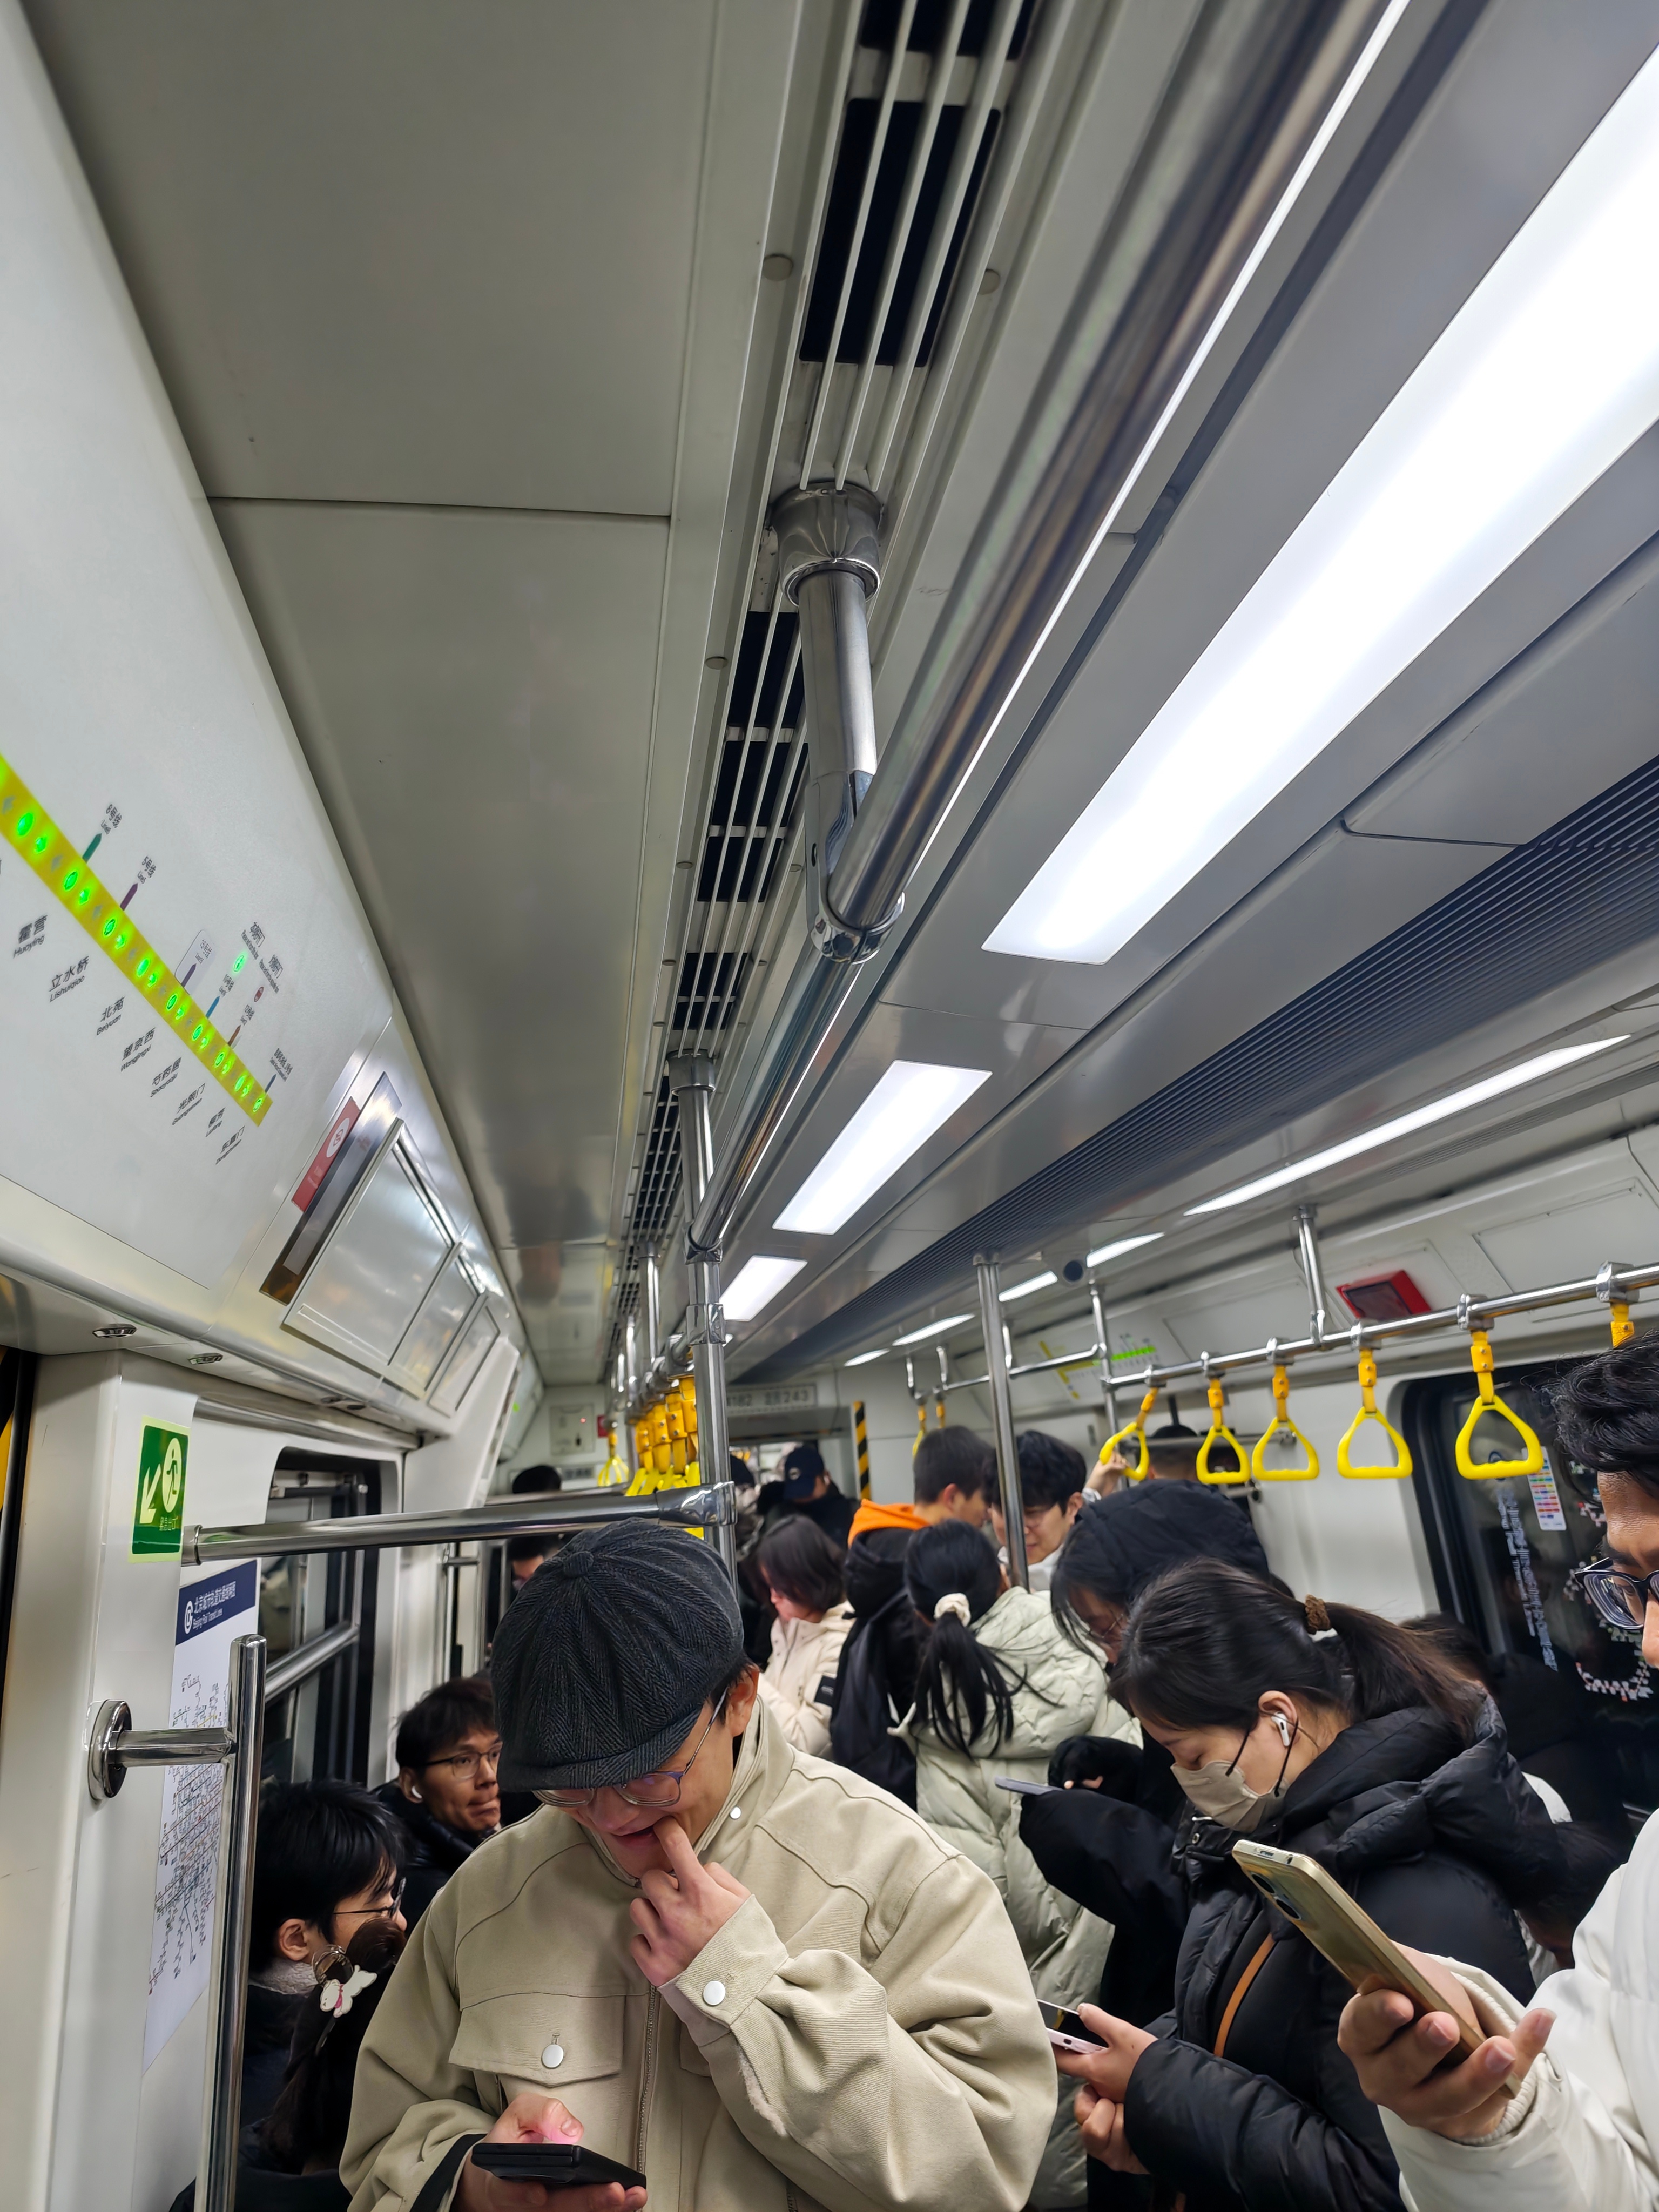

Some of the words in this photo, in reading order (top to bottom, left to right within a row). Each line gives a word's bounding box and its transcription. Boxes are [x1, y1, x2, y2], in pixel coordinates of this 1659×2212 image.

[106, 804, 122, 828] 8号线
[142, 856, 157, 878] 5号线
[18, 915, 48, 943] 霍营
[13, 934, 45, 958] Huoying
[49, 956, 89, 992] 立水桥
[50, 975, 85, 1002] Lishuiqiao
[100, 996, 125, 1022] 北苑
[96, 1014, 121, 1035] Beiyuan
[122, 1027, 156, 1061] 望京西
[152, 1057, 181, 1085] 芍药居
[177, 1083, 205, 1114] 光熙门
